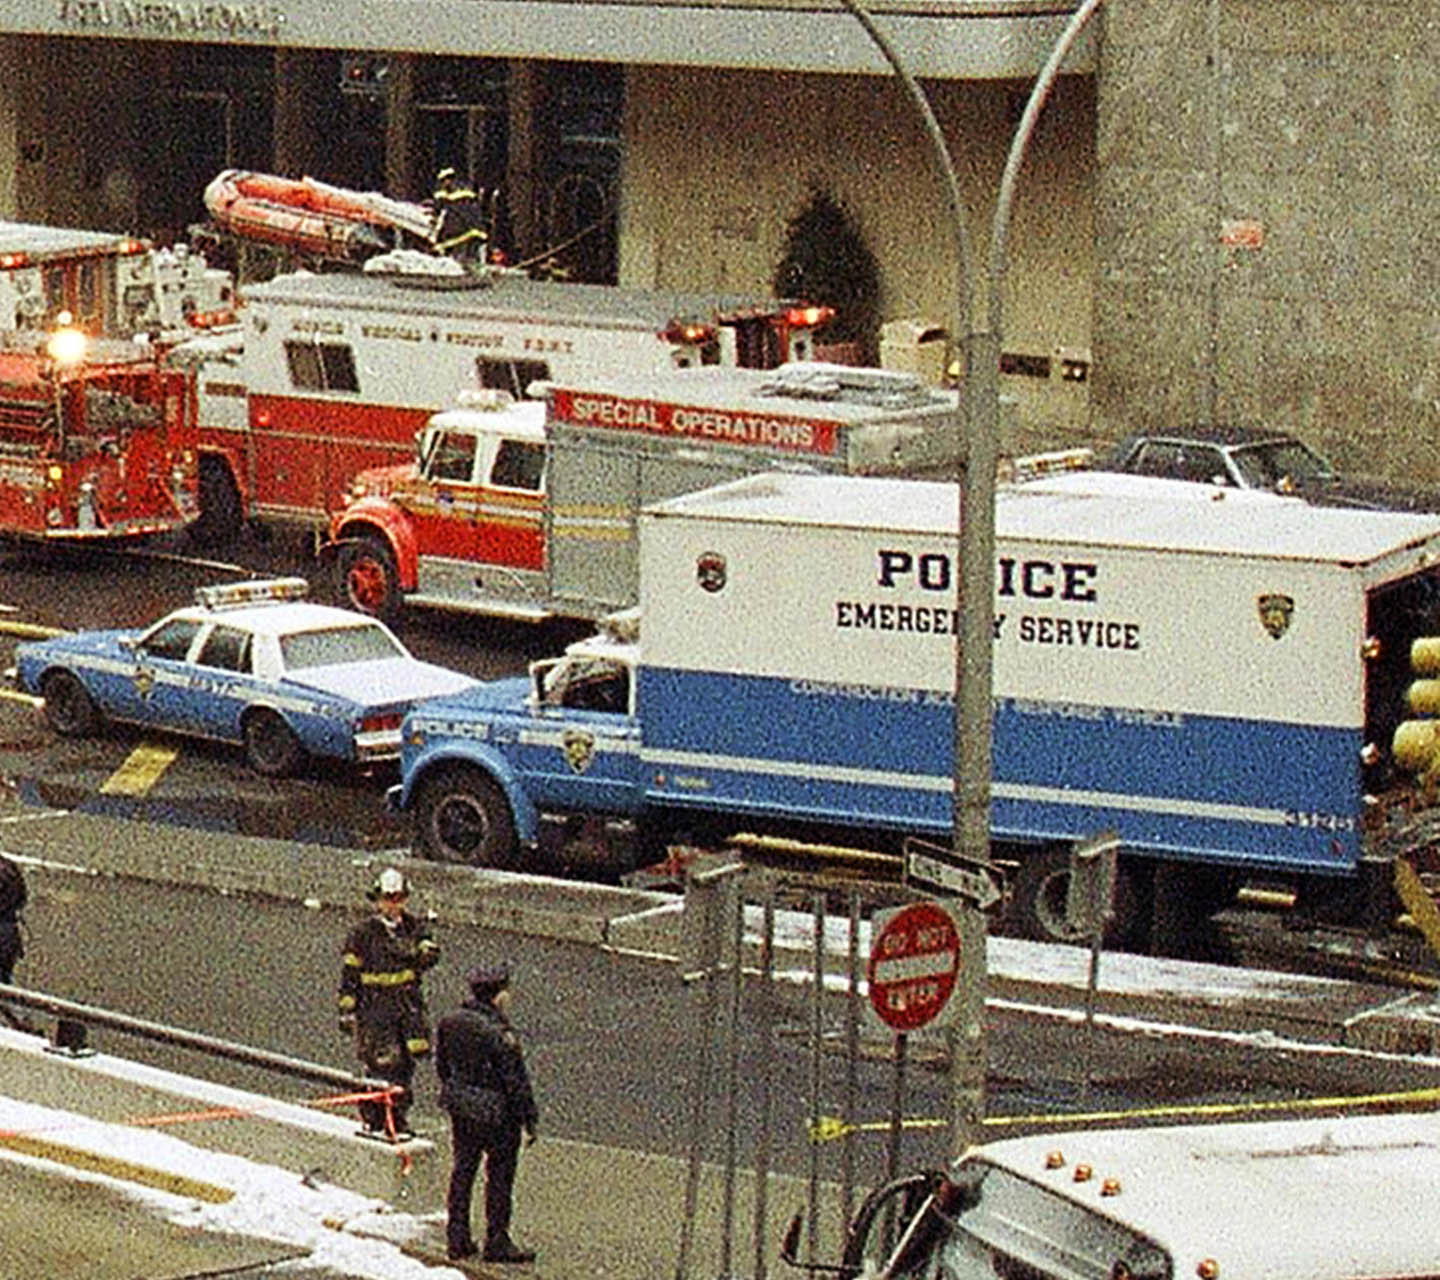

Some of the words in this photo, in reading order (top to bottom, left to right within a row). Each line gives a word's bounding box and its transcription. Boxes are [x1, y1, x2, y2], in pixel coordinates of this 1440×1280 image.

[572, 397, 664, 429] SPECIAL
[671, 408, 814, 447] OPERATIONS
[877, 549, 1099, 604] POICE
[1019, 615, 1141, 651] SERVICE
[916, 925, 950, 953] NOT
